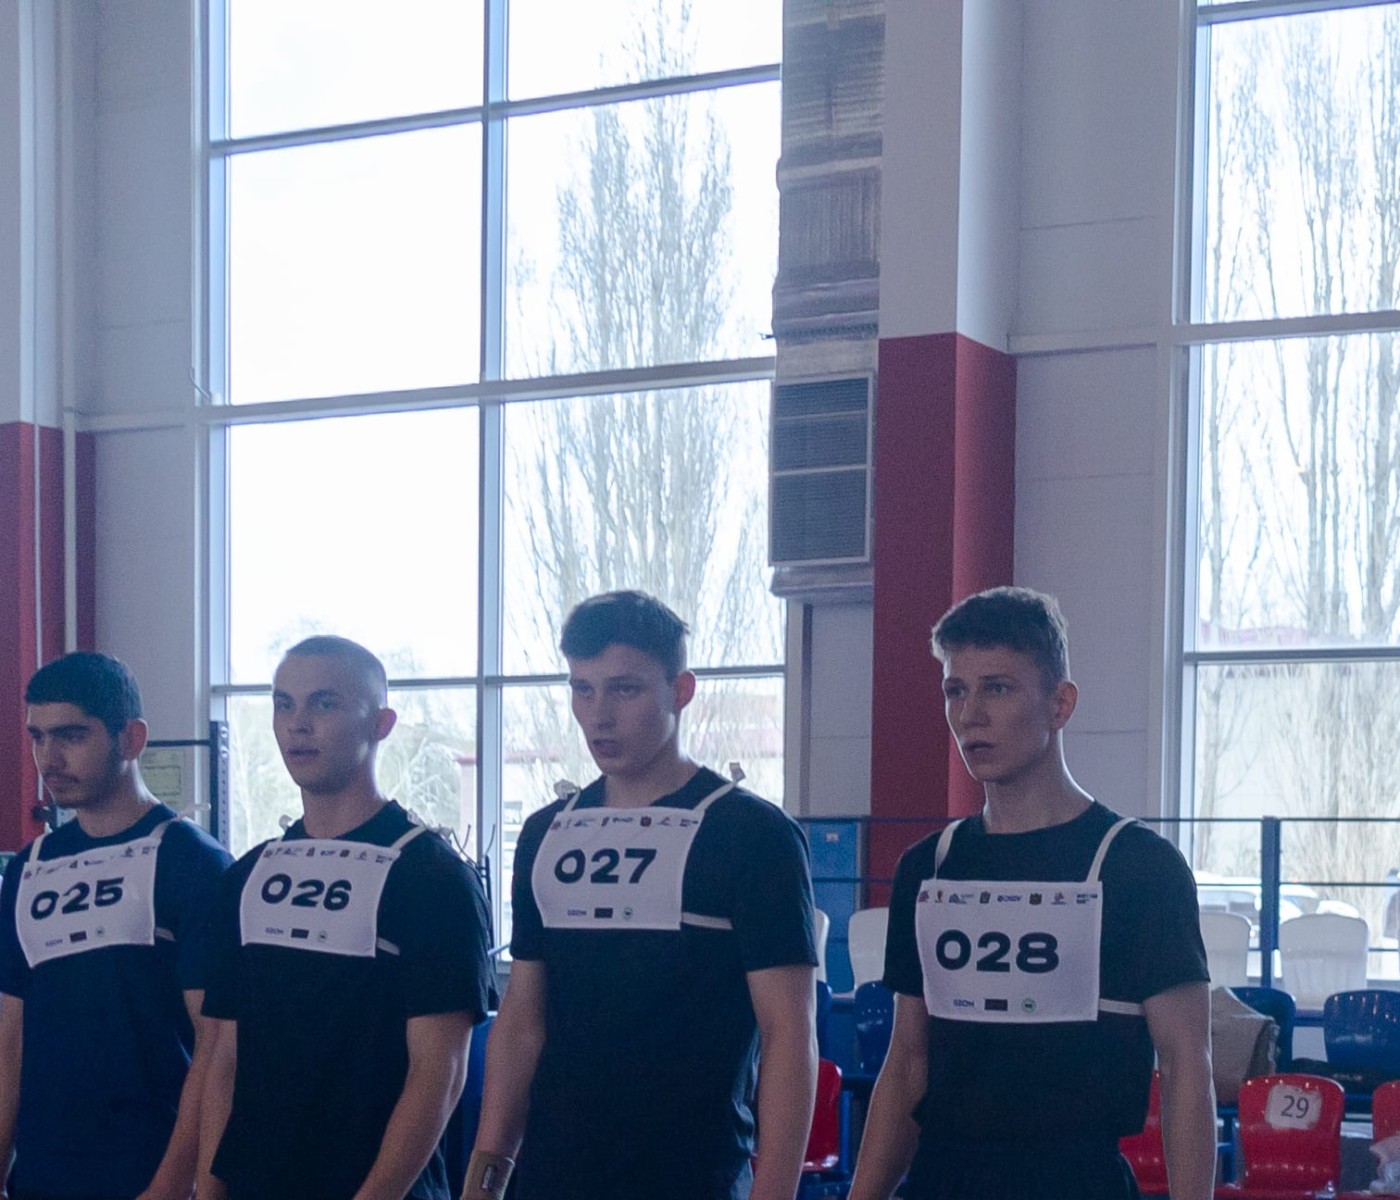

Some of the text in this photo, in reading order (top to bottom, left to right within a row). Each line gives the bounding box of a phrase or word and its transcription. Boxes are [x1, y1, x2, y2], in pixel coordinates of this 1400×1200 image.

[554, 848, 657, 884] 027
[30, 876, 124, 920] 025
[261, 873, 352, 911] 026
[935, 929, 1060, 974] 028
[1280, 1094, 1309, 1120] 29
